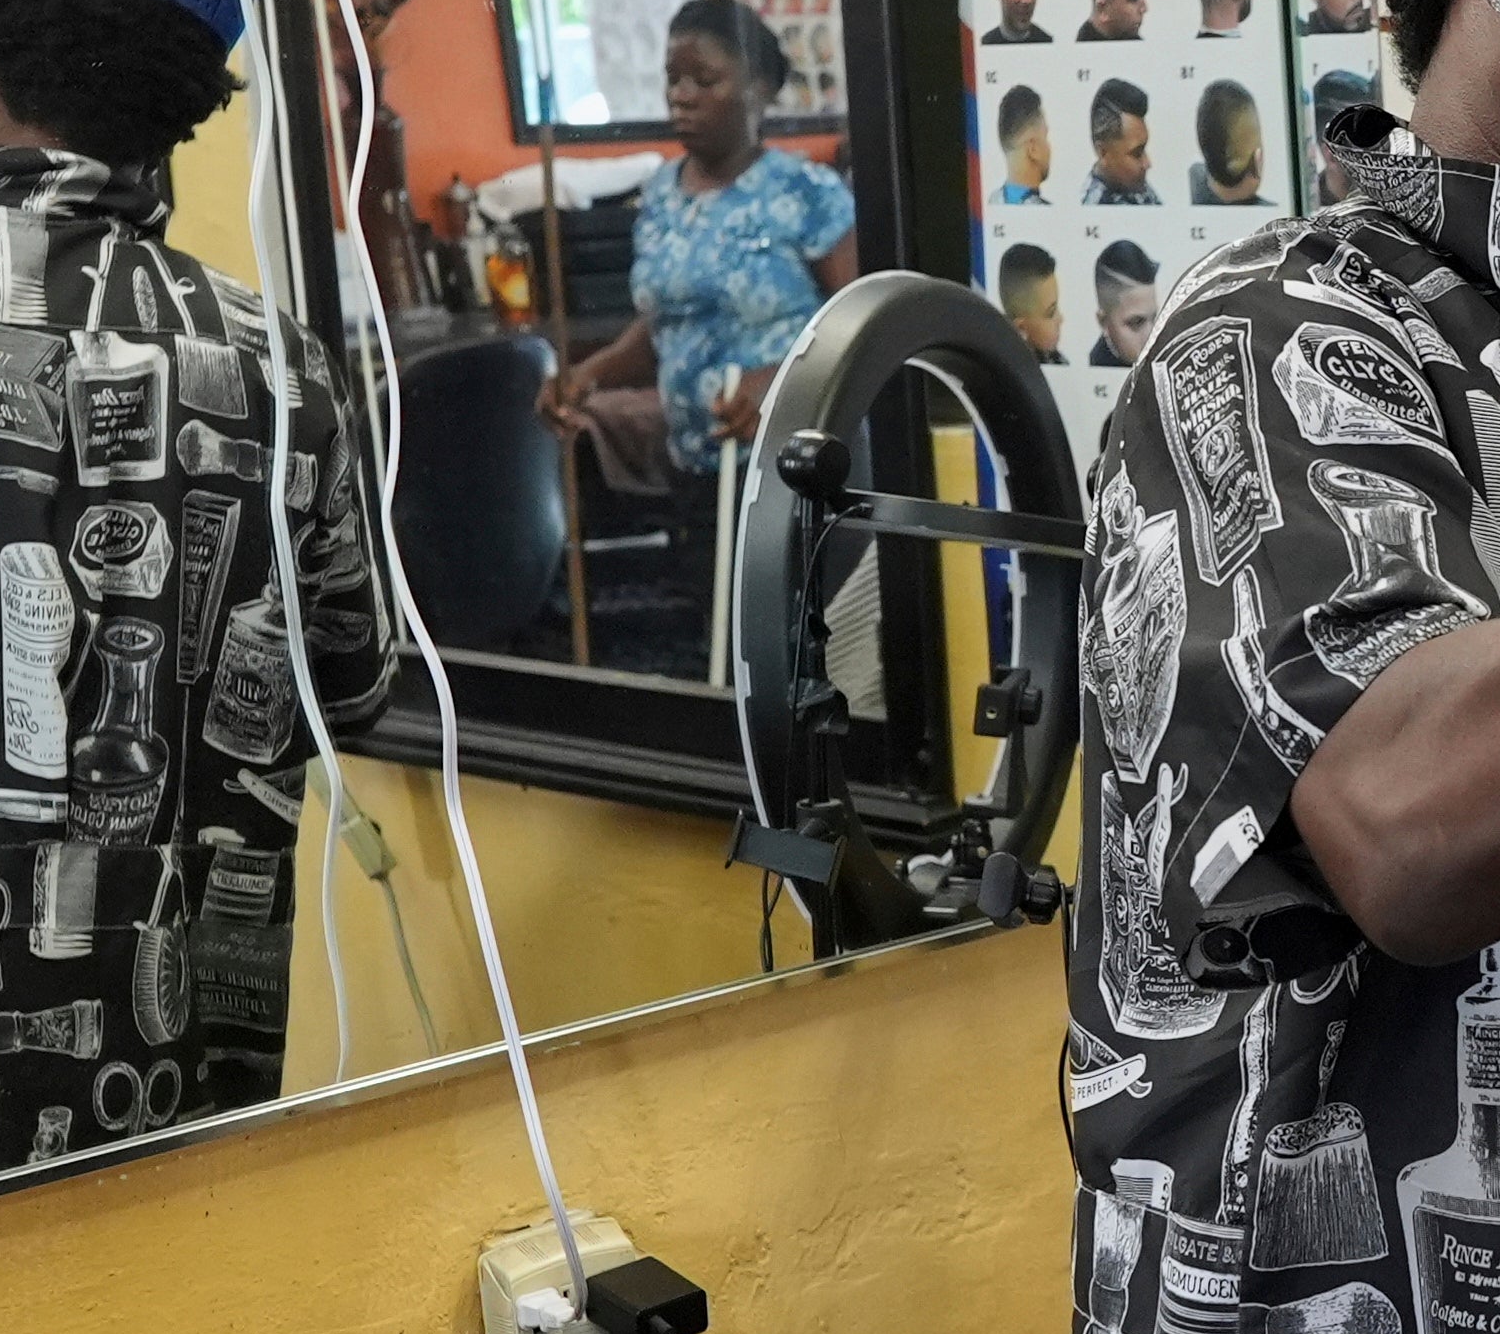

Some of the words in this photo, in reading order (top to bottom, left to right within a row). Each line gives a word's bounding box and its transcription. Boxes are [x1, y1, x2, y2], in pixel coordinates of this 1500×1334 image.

[1440, 1233, 1494, 1268] RINCE
[1431, 1300, 1474, 1328] Colgate
[1476, 1314, 1487, 1331] &
